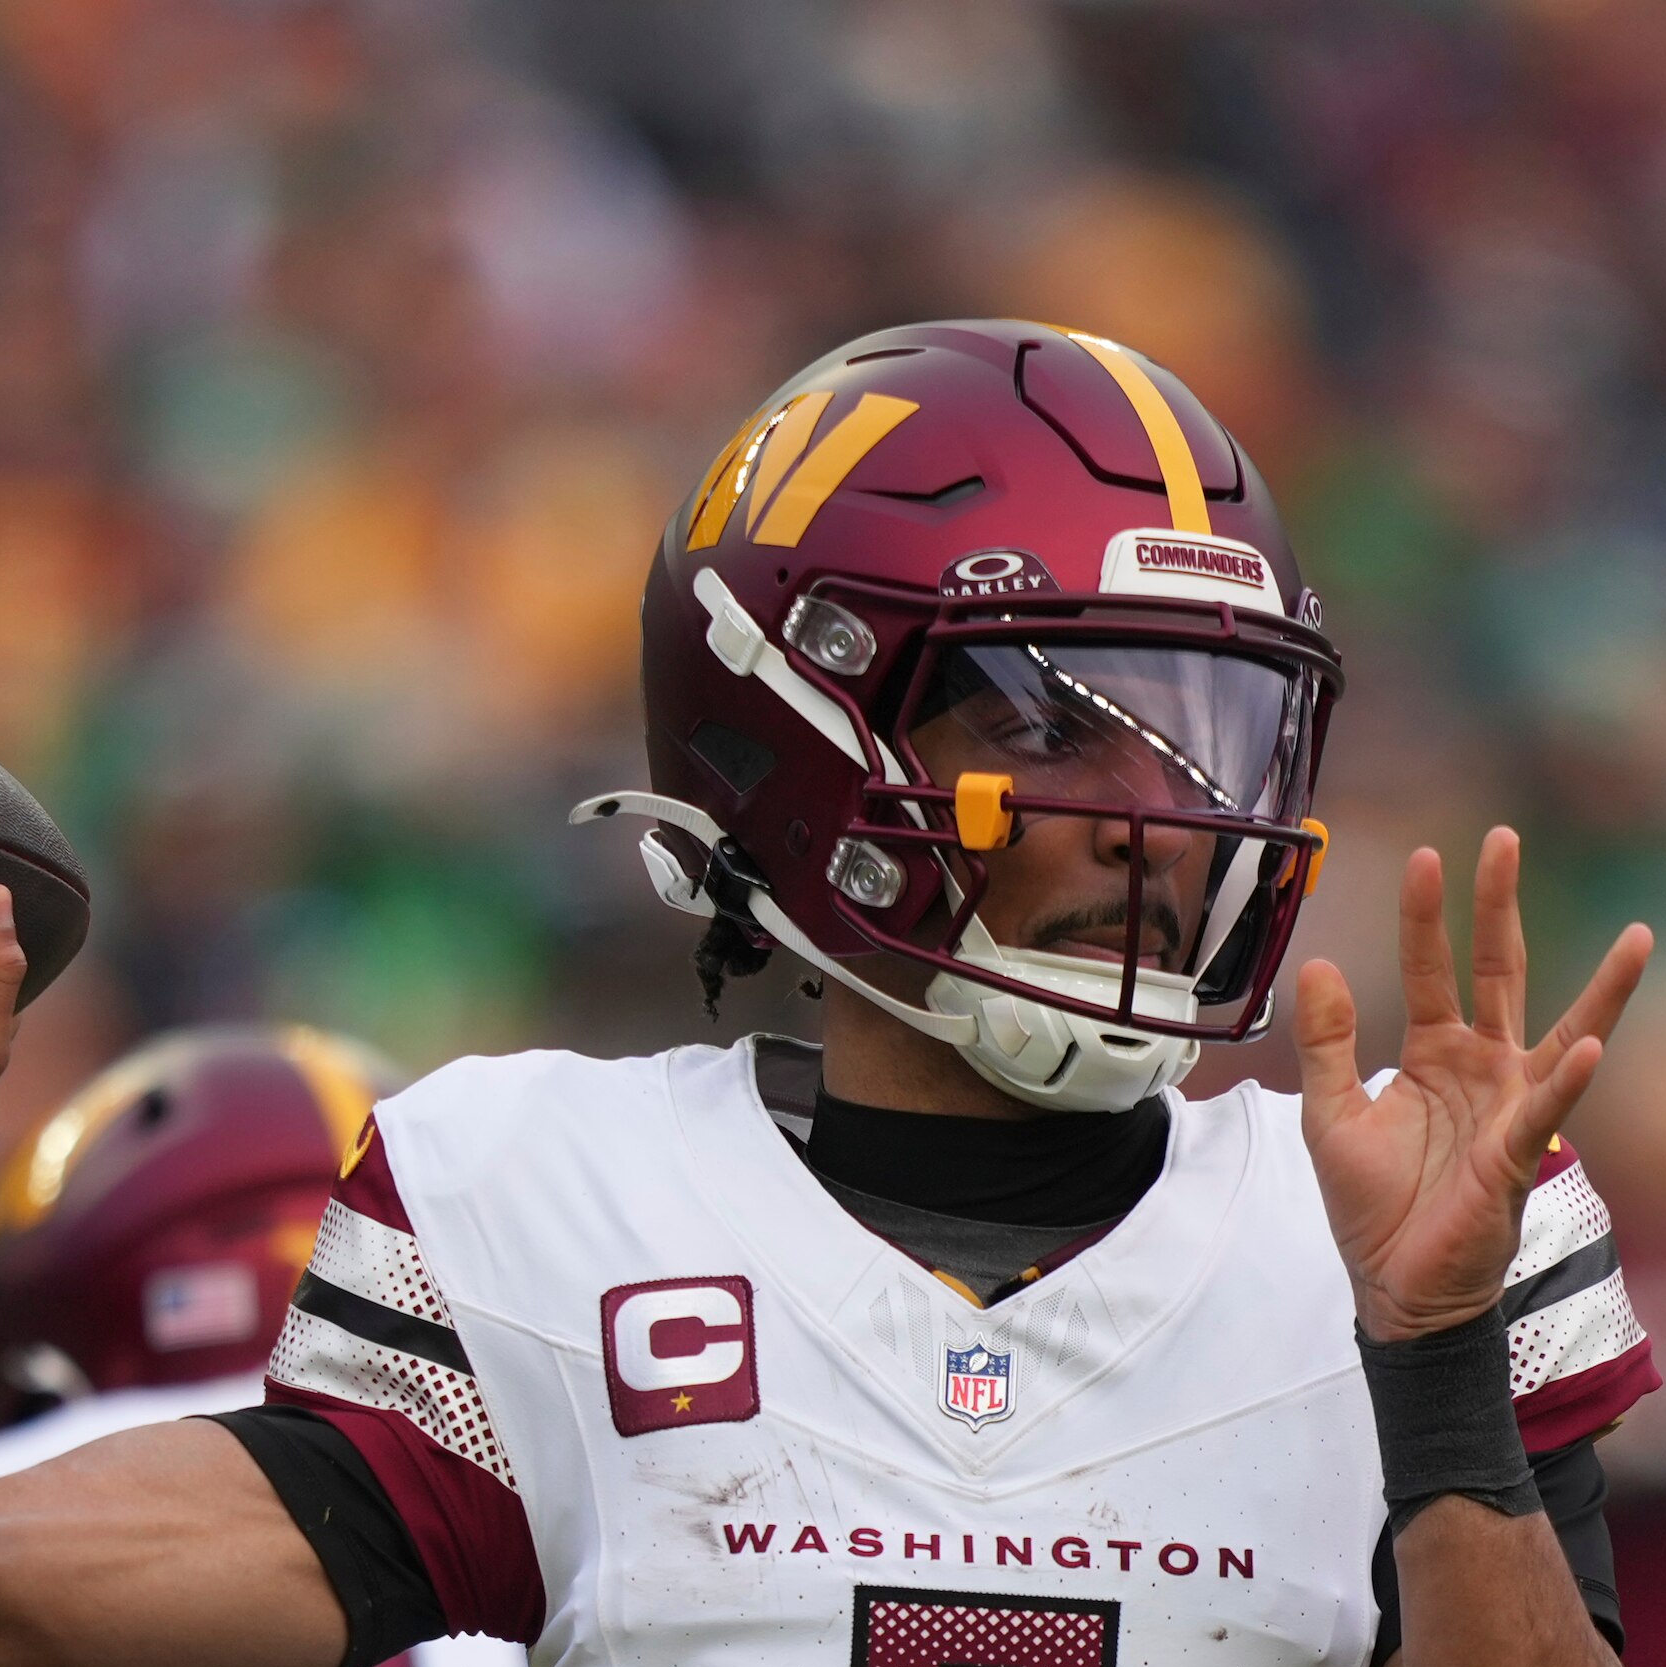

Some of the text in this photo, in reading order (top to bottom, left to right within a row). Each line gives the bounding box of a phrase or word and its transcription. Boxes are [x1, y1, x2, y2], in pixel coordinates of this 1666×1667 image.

[1136, 543, 1265, 583] COMMANDERS
[942, 574, 1042, 597] OAKLEY
[614, 1286, 744, 1392] C
[951, 1376, 1003, 1413] NFL
[724, 1523, 1255, 1579] WASHINGTON
